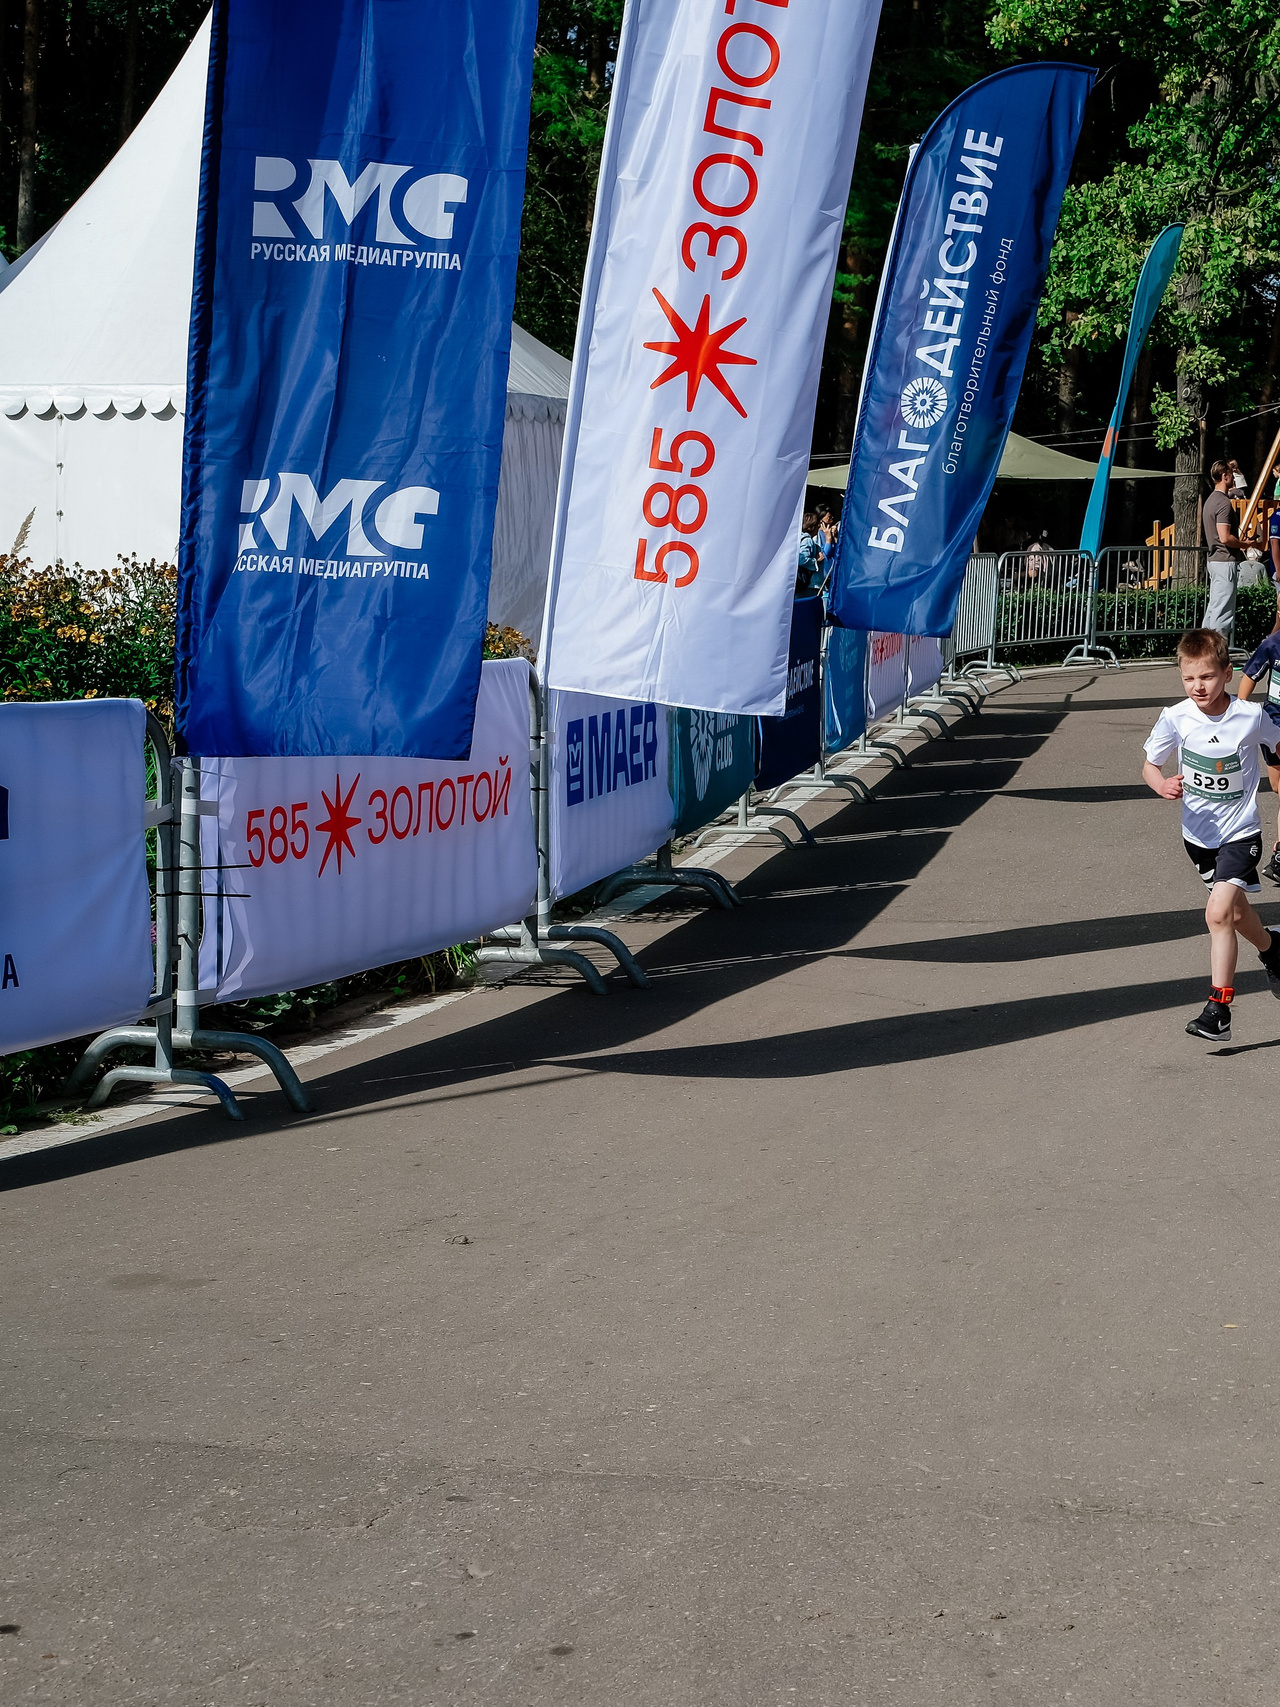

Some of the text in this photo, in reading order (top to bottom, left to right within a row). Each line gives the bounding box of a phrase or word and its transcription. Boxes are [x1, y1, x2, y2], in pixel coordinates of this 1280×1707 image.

[252, 156, 469, 246] RMG
[250, 242, 462, 271] РУССКАЯ МЕДИАГРУППА
[941, 237, 1015, 475] благотворительный фонд
[238, 472, 440, 557] RMG
[634, 427, 716, 588] 585
[299, 556, 430, 580] МЕДИАГРУППА
[715, 734, 733, 772] CLUB
[1193, 772, 1230, 791] 529
[246, 755, 512, 868] 585 ЗОЛОТОЙ
